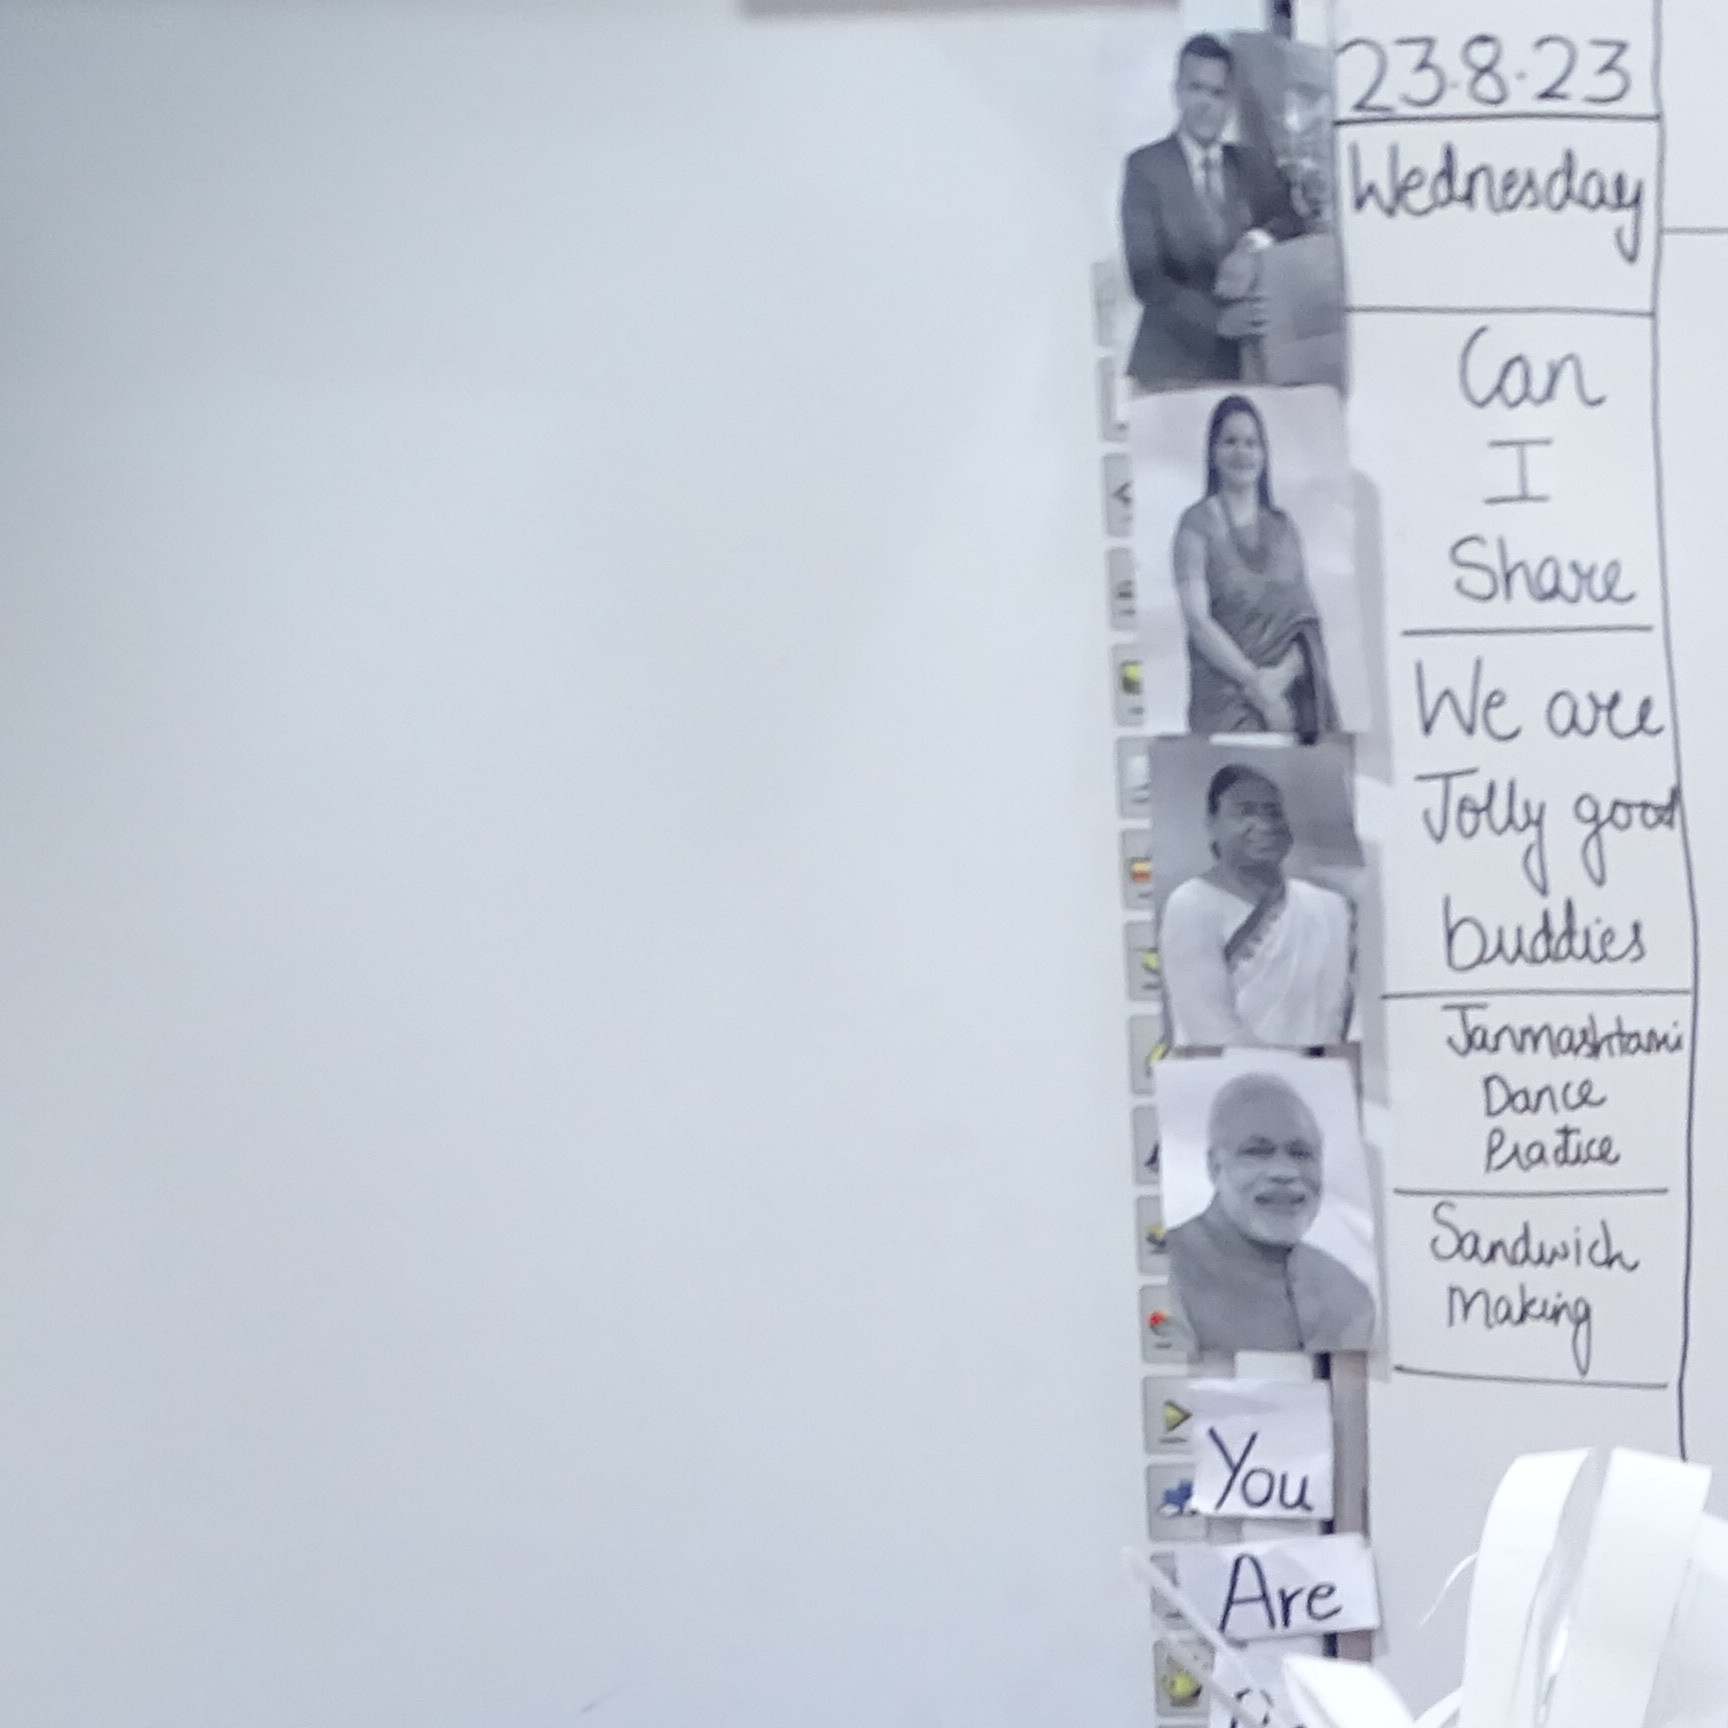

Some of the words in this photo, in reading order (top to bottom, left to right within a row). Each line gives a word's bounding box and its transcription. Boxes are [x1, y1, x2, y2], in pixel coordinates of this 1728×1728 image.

[1349, 141, 1645, 264] Wednesday
[1459, 325, 1606, 409] Can
[1483, 438, 1553, 505] I
[1449, 534, 1637, 605] Share
[1415, 656, 1522, 742] We
[1546, 688, 1665, 740] are
[1414, 768, 1550, 897] Jolly
[1574, 785, 1678, 887] good
[1442, 893, 1647, 973] buddies
[1482, 1073, 1608, 1118] Dance
[1429, 1200, 1640, 1273] Sandwich
[1207, 1426, 1316, 1512] You
[1217, 1553, 1344, 1634] Are
